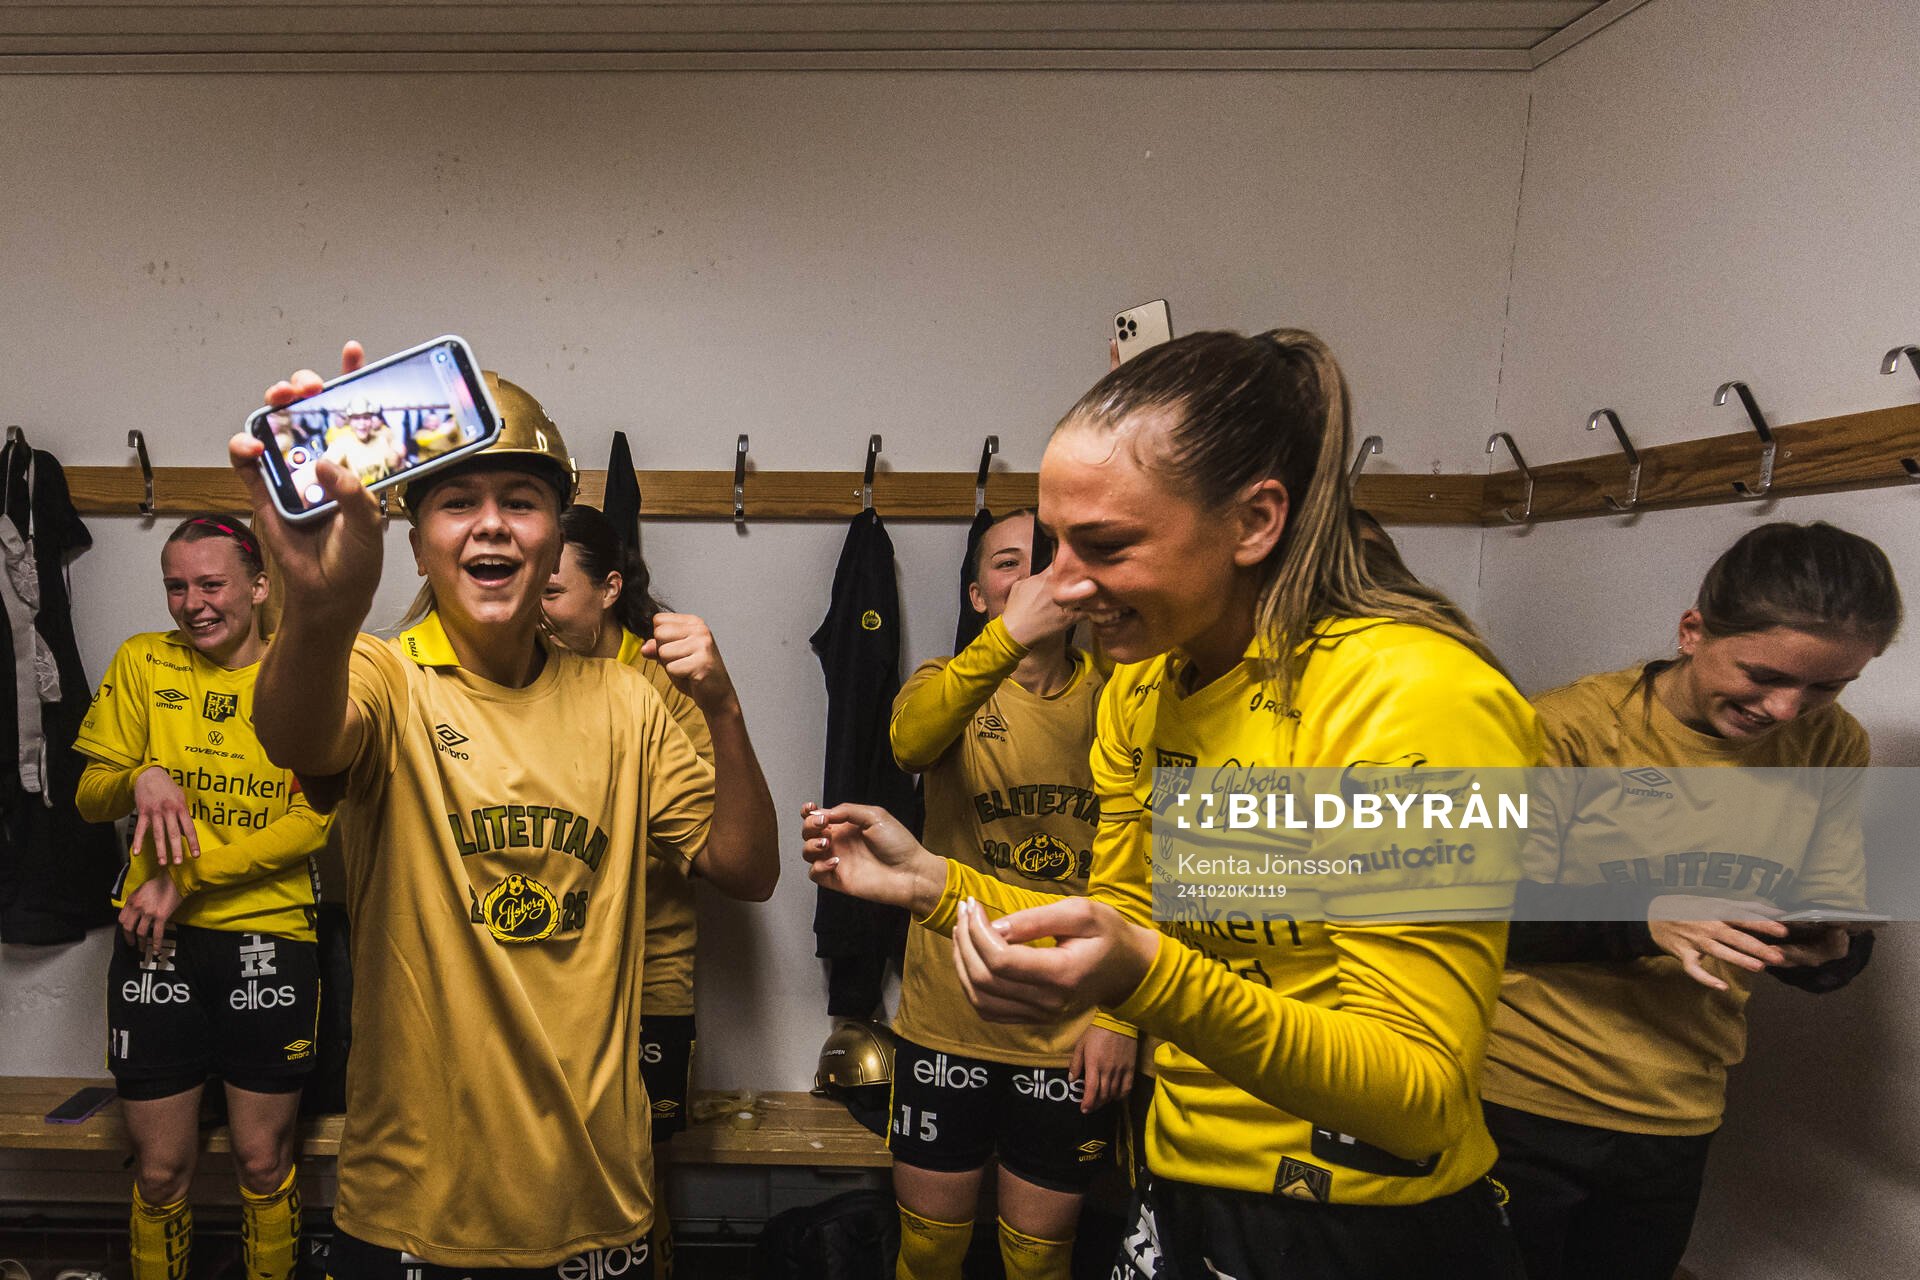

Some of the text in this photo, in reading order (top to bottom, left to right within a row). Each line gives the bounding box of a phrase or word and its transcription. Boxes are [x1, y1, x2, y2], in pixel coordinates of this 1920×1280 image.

[156, 702, 183, 711] umbro
[184, 745, 229, 759] TOVEKS
[1626, 787, 1674, 800] umbro
[1077, 849, 1092, 878] 2
[1350, 838, 1476, 873] autocirc
[122, 973, 190, 1004] ellos
[229, 980, 297, 1010] ellos
[913, 1053, 988, 1089] ellos
[1012, 1069, 1085, 1103] ellos
[901, 1103, 938, 1142] 15
[557, 1236, 648, 1280] ellos
